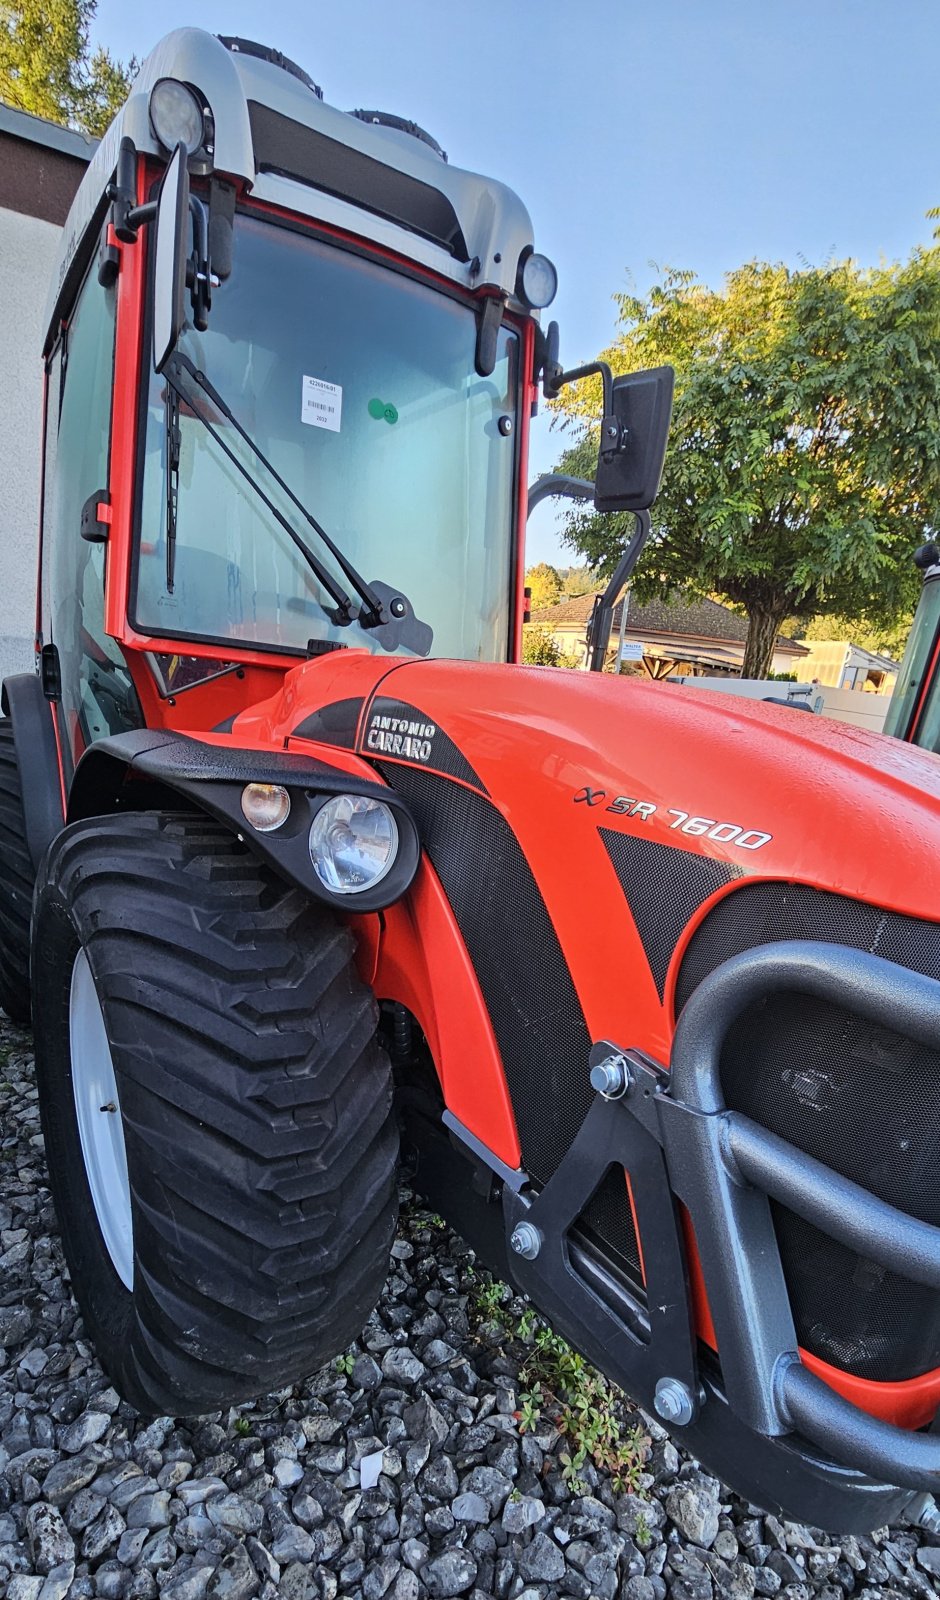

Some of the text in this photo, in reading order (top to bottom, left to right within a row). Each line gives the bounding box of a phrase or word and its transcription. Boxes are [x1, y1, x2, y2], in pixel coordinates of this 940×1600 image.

[370, 715, 436, 738] ANTONIO
[367, 729, 432, 761] CARRARO
[606, 796, 773, 850] SR 7600
